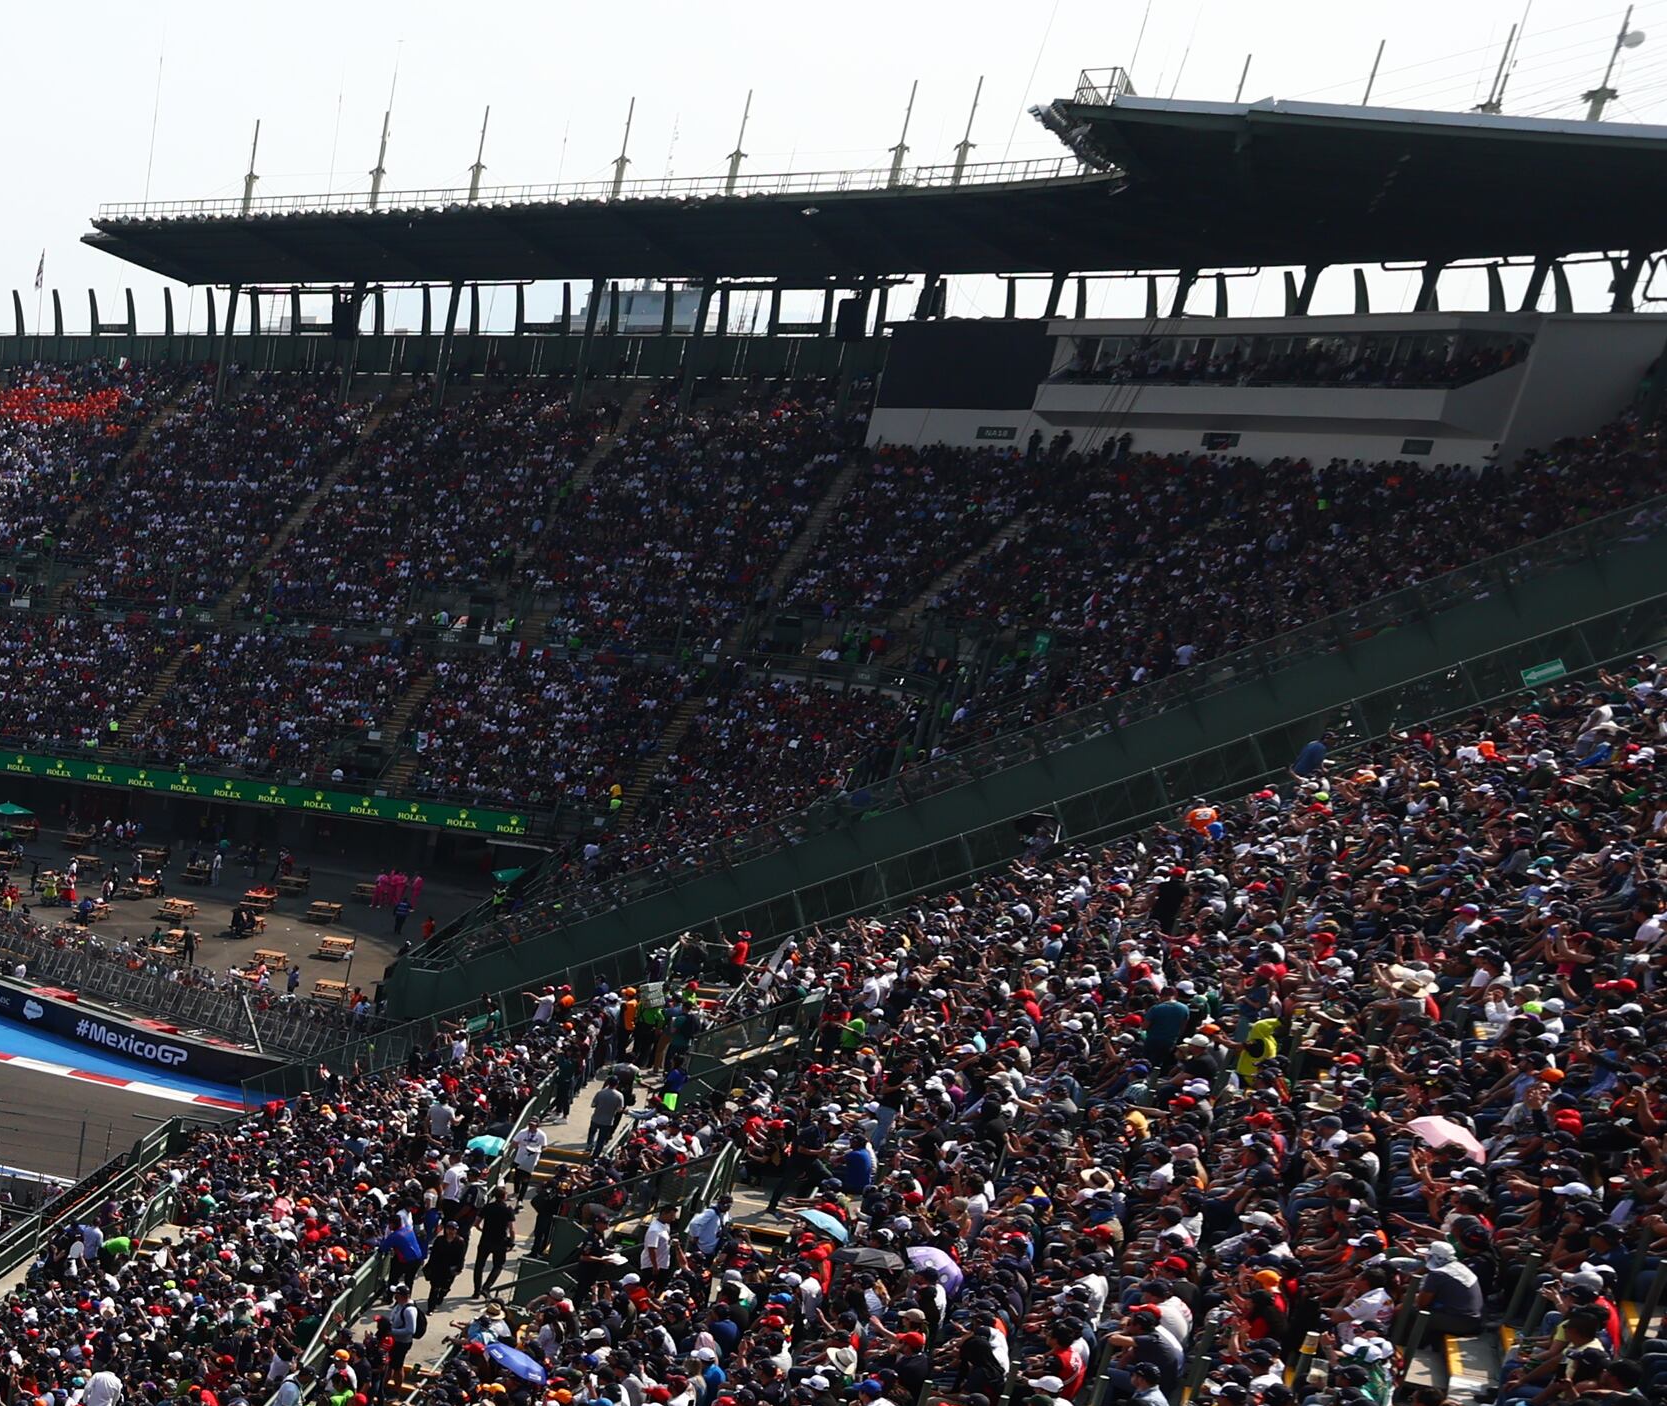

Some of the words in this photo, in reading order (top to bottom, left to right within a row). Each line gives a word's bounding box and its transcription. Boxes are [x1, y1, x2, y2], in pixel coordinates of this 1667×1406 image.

[7, 763, 32, 773] ROLEX
[46, 768, 71, 777] ROLEX
[87, 773, 112, 783] ROLEX
[128, 778, 154, 788] ROLEX
[170, 783, 197, 793] ROLEX
[213, 789, 241, 799] ROLEX
[258, 794, 286, 804] ROLEX
[303, 800, 332, 810] ROLEX
[350, 806, 379, 816] ROLEX
[397, 812, 427, 822] ROLEX
[447, 818, 477, 829] ROLEX
[75, 1018, 188, 1066] #MexicoGP
